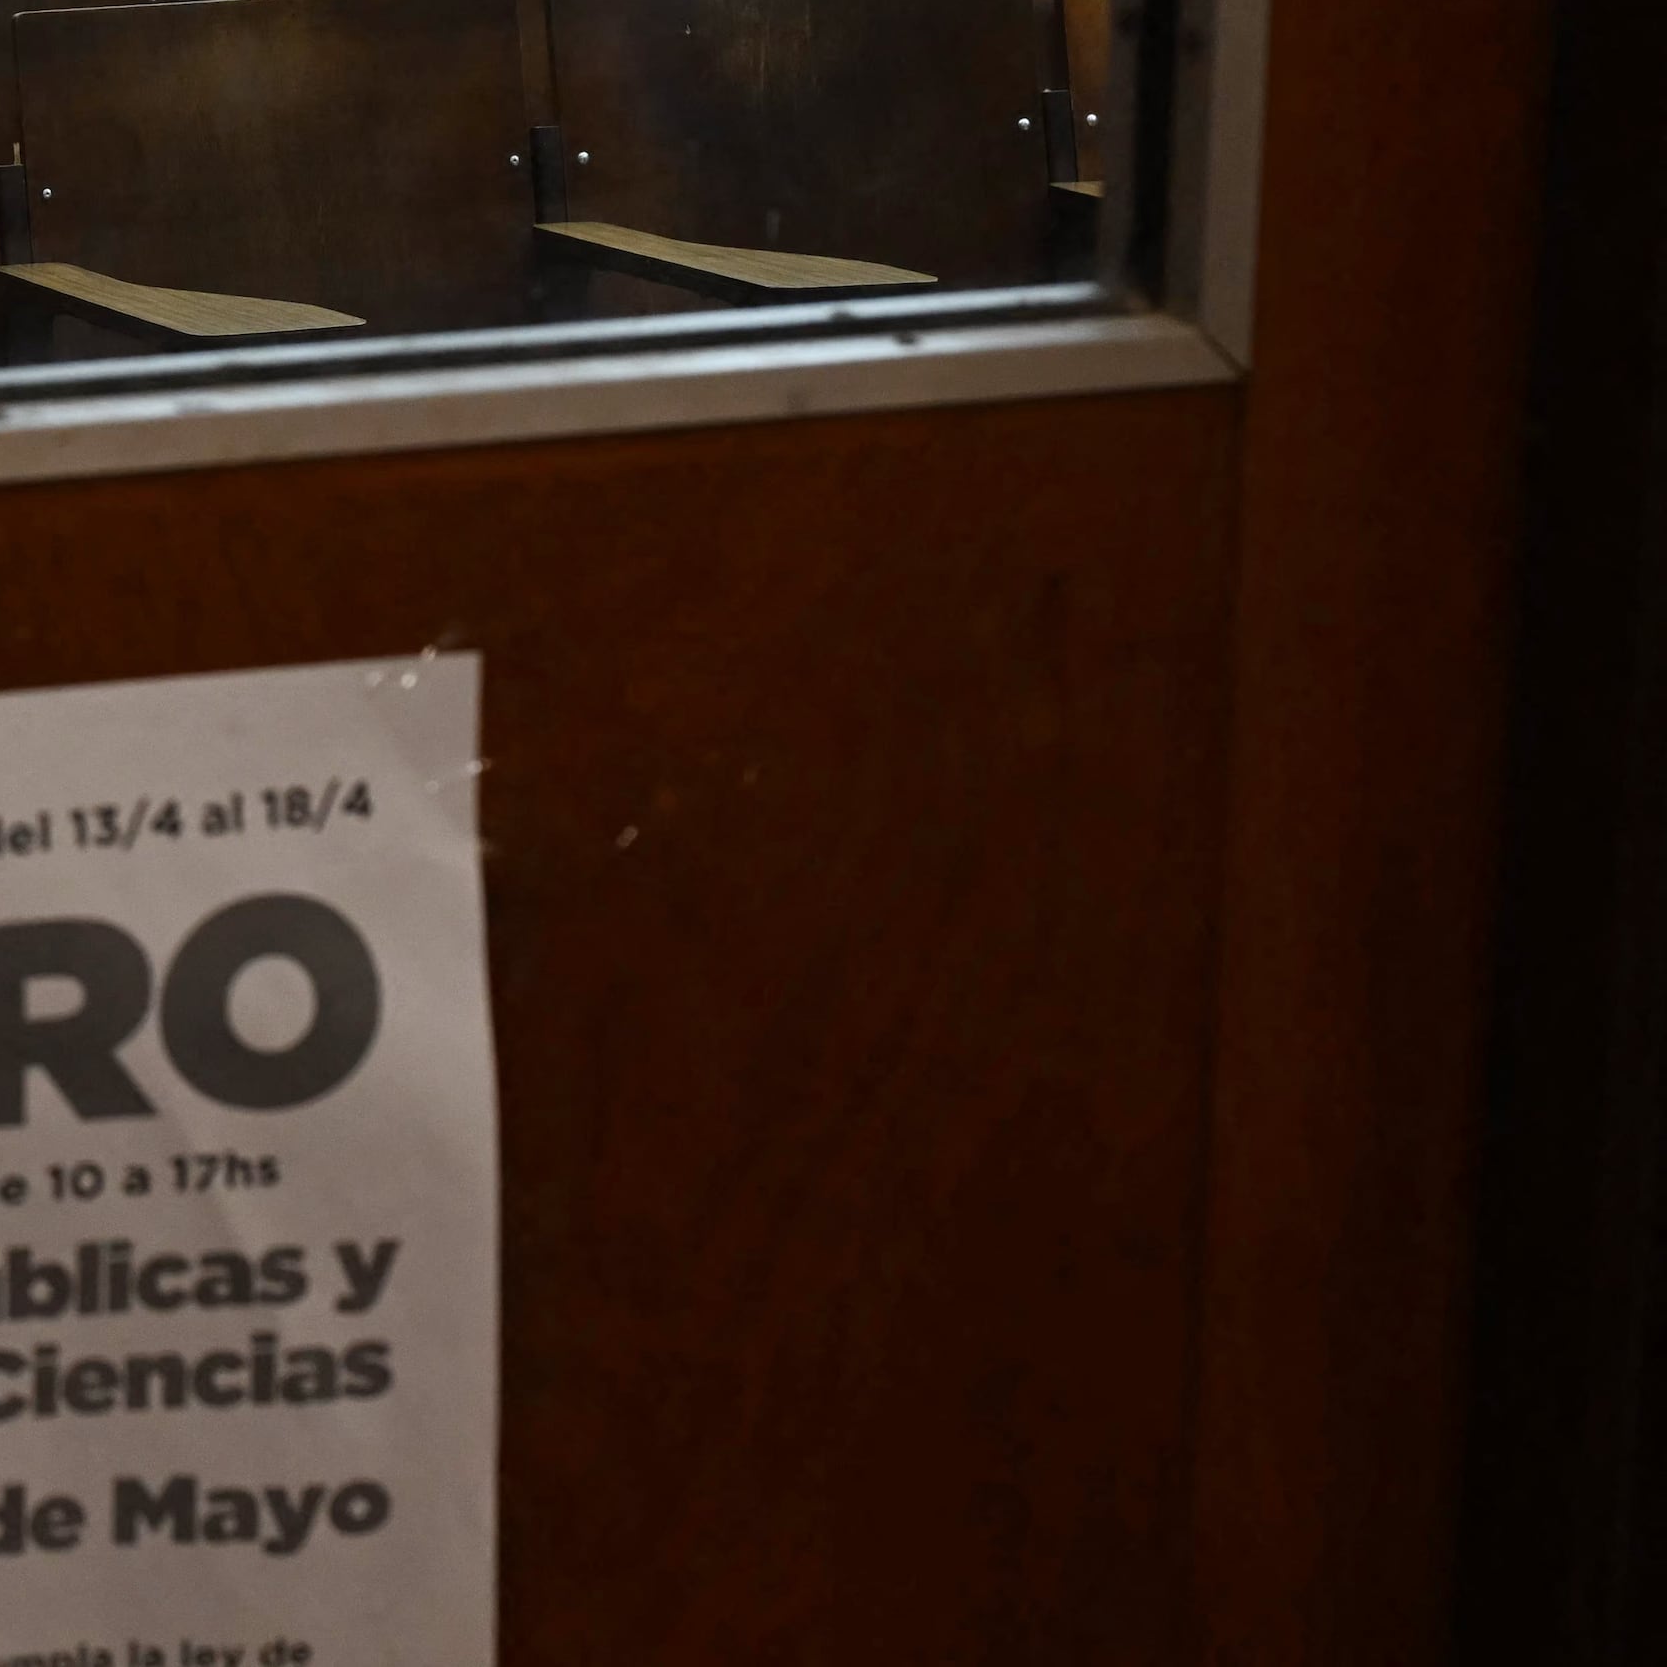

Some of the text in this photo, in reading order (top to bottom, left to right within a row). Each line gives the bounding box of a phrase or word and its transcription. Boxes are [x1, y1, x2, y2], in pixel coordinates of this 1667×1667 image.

[70, 796, 182, 852] 13/4
[200, 791, 245, 837] al
[260, 775, 374, 833] 18/4
[48, 1162, 104, 1203] 10
[120, 1161, 153, 1198] a
[168, 1149, 282, 1193] 17hs
[331, 1236, 401, 1316] y
[110, 1474, 391, 1557] Mayo
[256, 1636, 314, 1667] de
